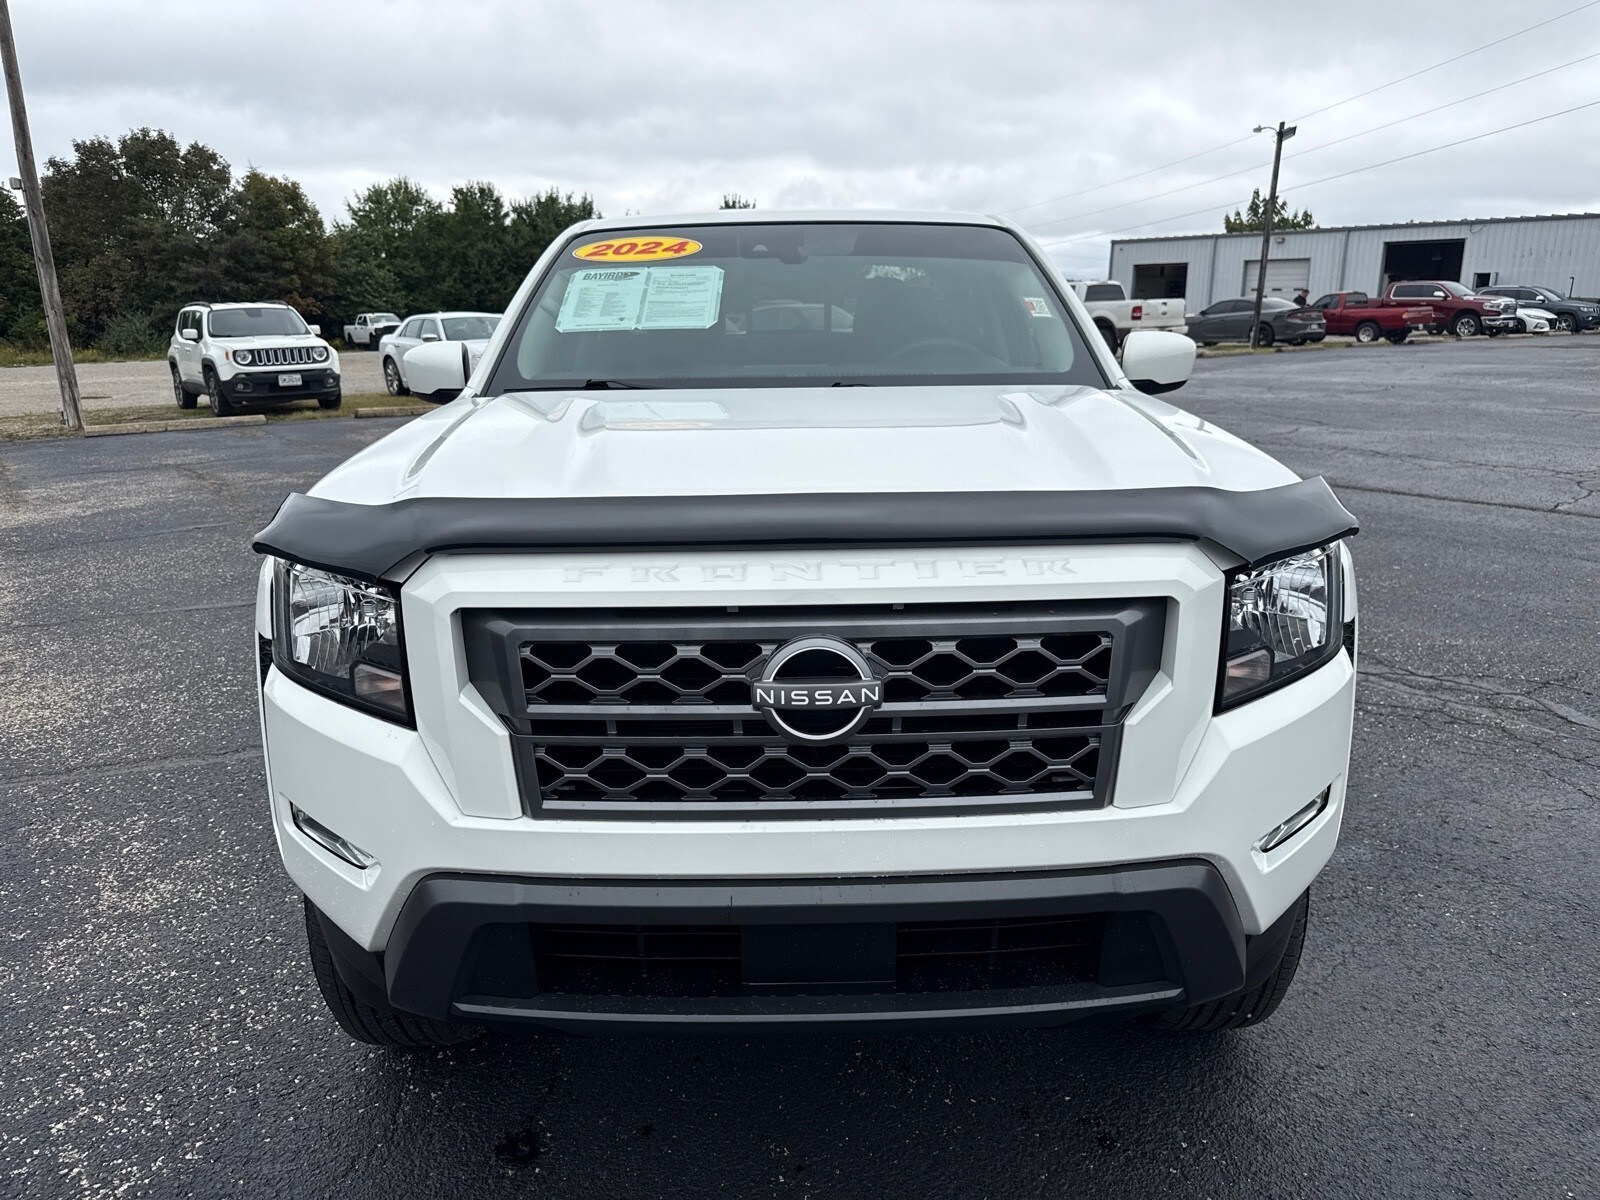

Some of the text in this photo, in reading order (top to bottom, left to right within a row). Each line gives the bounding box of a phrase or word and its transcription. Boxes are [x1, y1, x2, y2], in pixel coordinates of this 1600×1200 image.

[585, 241, 689, 257] 2024
[582, 271, 624, 281] BAYIRD
[562, 556, 1078, 583] FRONTIER
[756, 686, 879, 705] NISSAN
